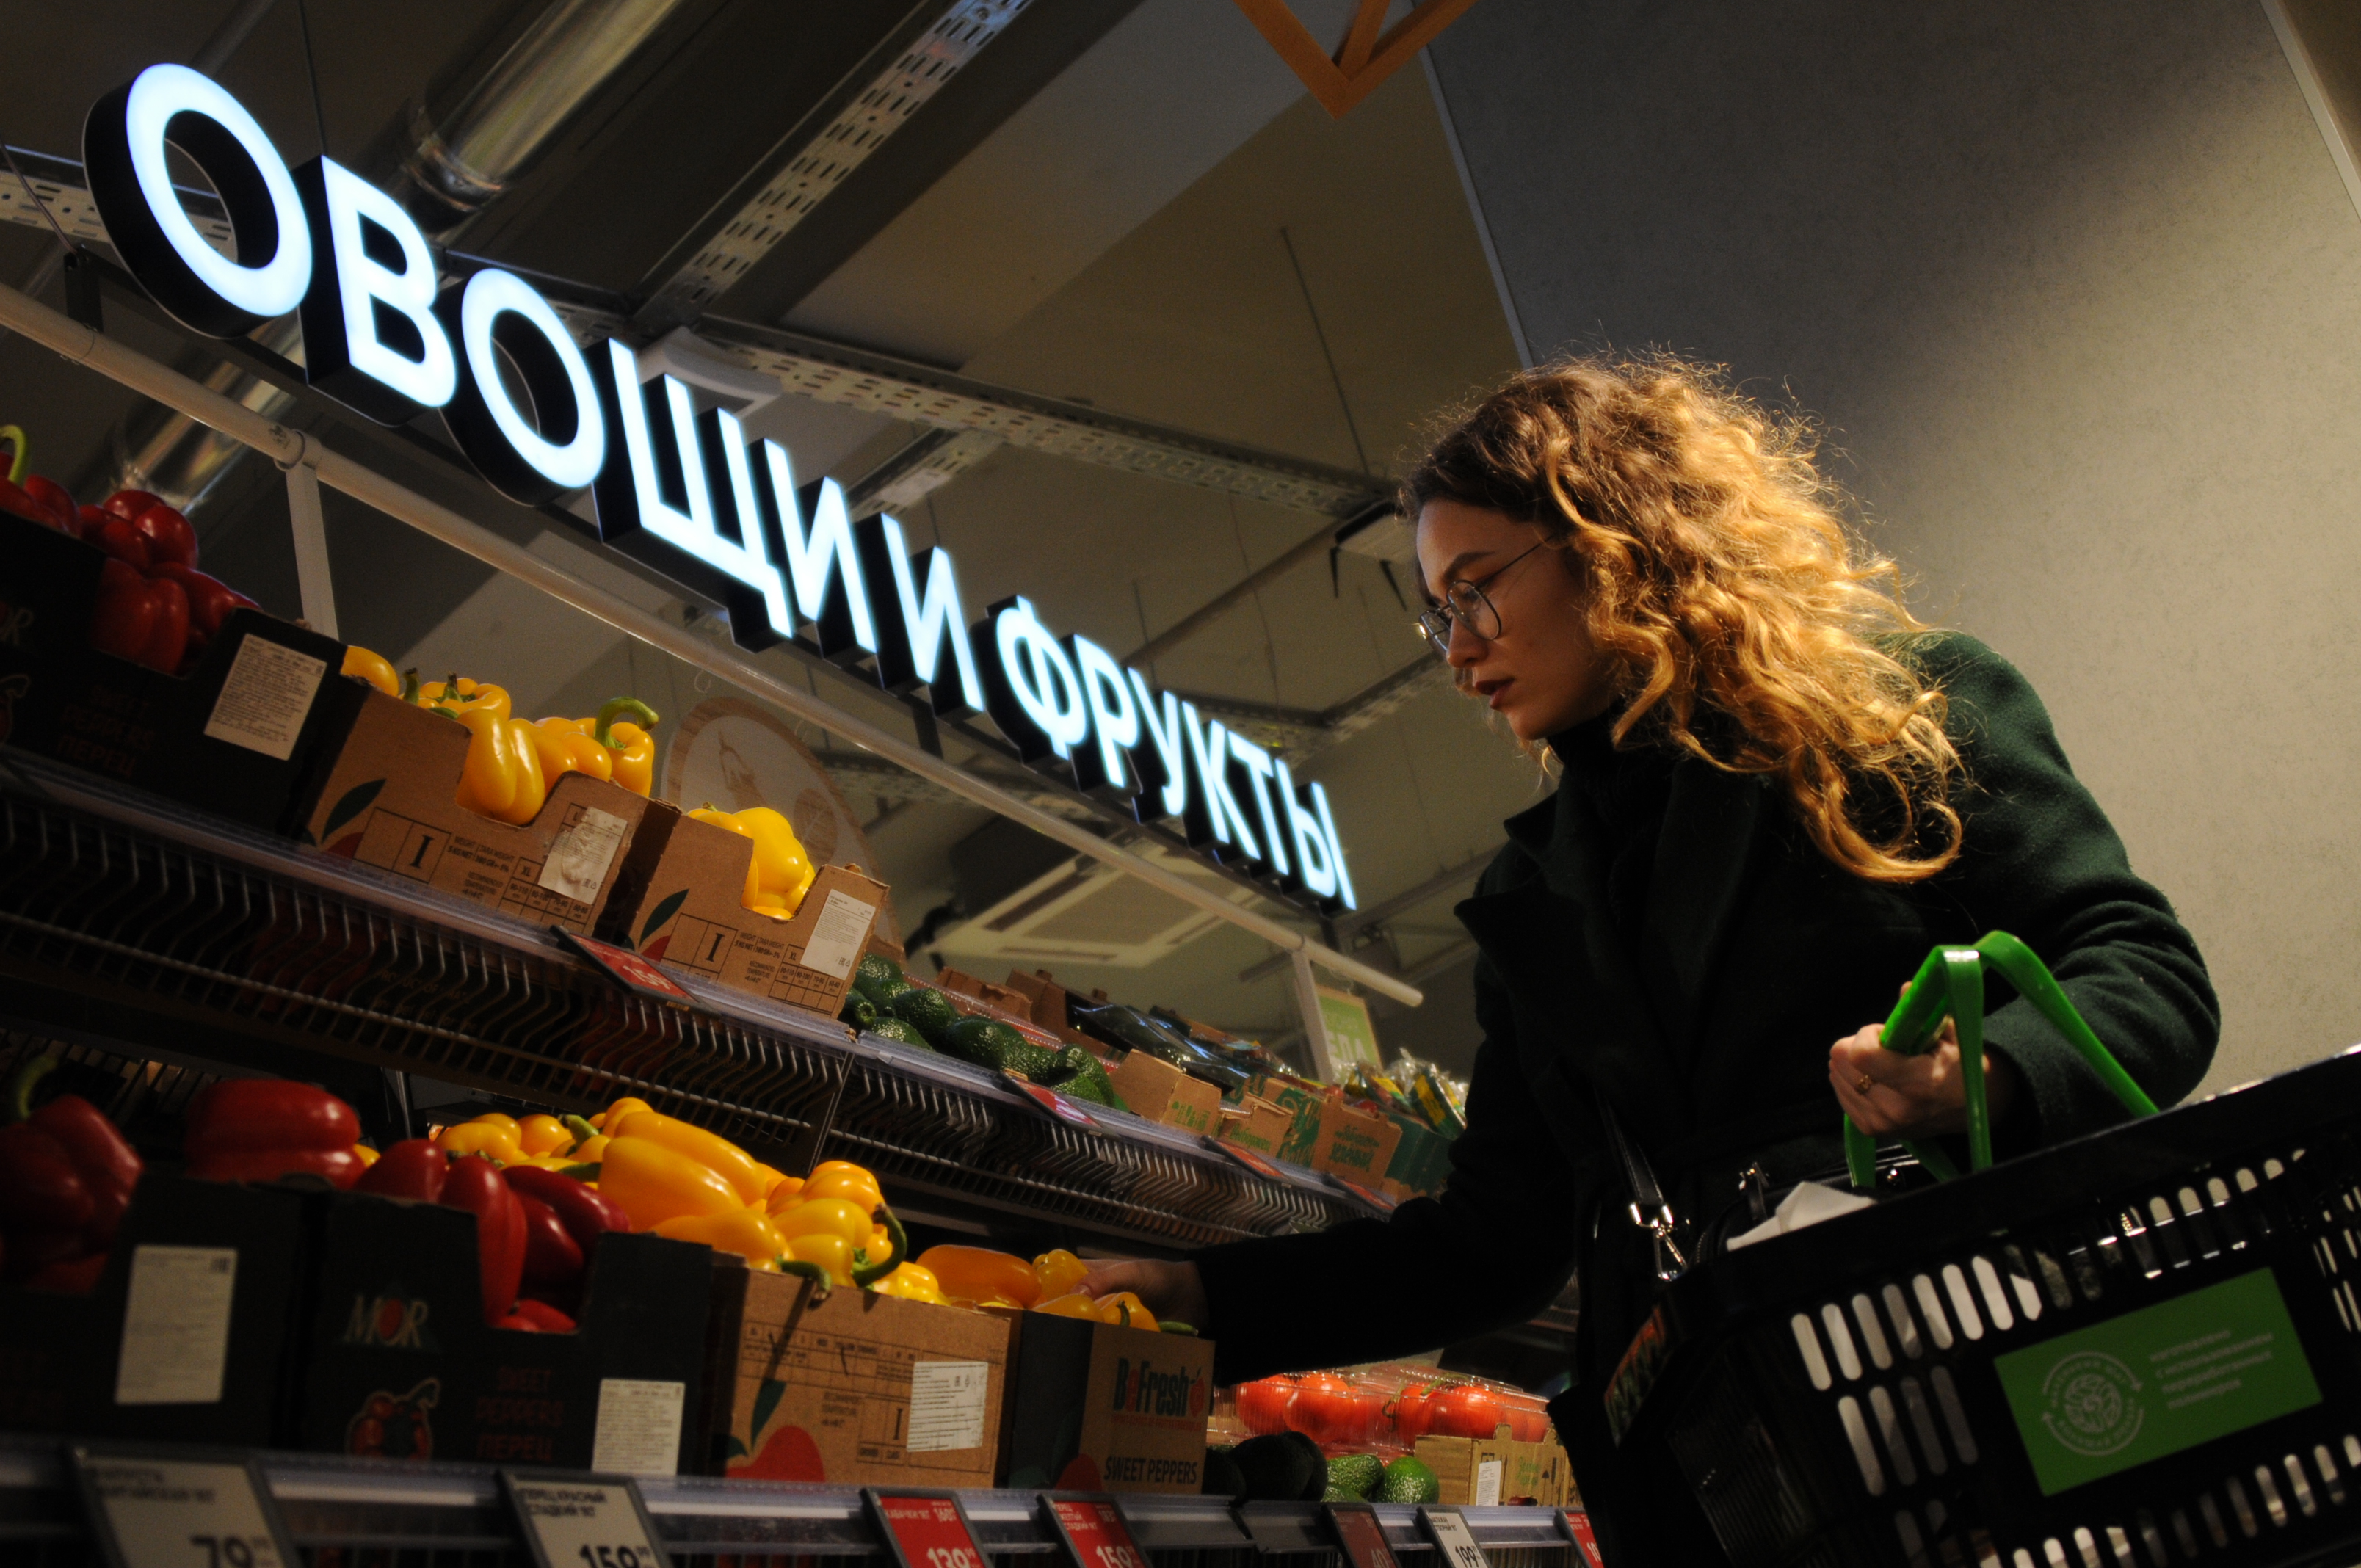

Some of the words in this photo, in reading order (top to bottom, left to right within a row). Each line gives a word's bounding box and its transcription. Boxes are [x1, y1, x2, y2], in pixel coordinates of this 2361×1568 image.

[126, 62, 877, 654] ОВОЩИ
[882, 513, 984, 711] И
[996, 595, 1357, 911] ФРУКТЫ
[521, 863, 532, 877] XL
[788, 951, 797, 961] XL
[344, 1294, 429, 1349] MOR
[1113, 1357, 1189, 1417] BeFresh
[476, 1432, 554, 1464] ПЕРЕЦ
[1103, 1456, 1147, 1482] SWEET
[1147, 1459, 1198, 1484] PEPPERS
[1095, 1545, 1134, 1568] 159
[1454, 1545, 1479, 1568] 199
